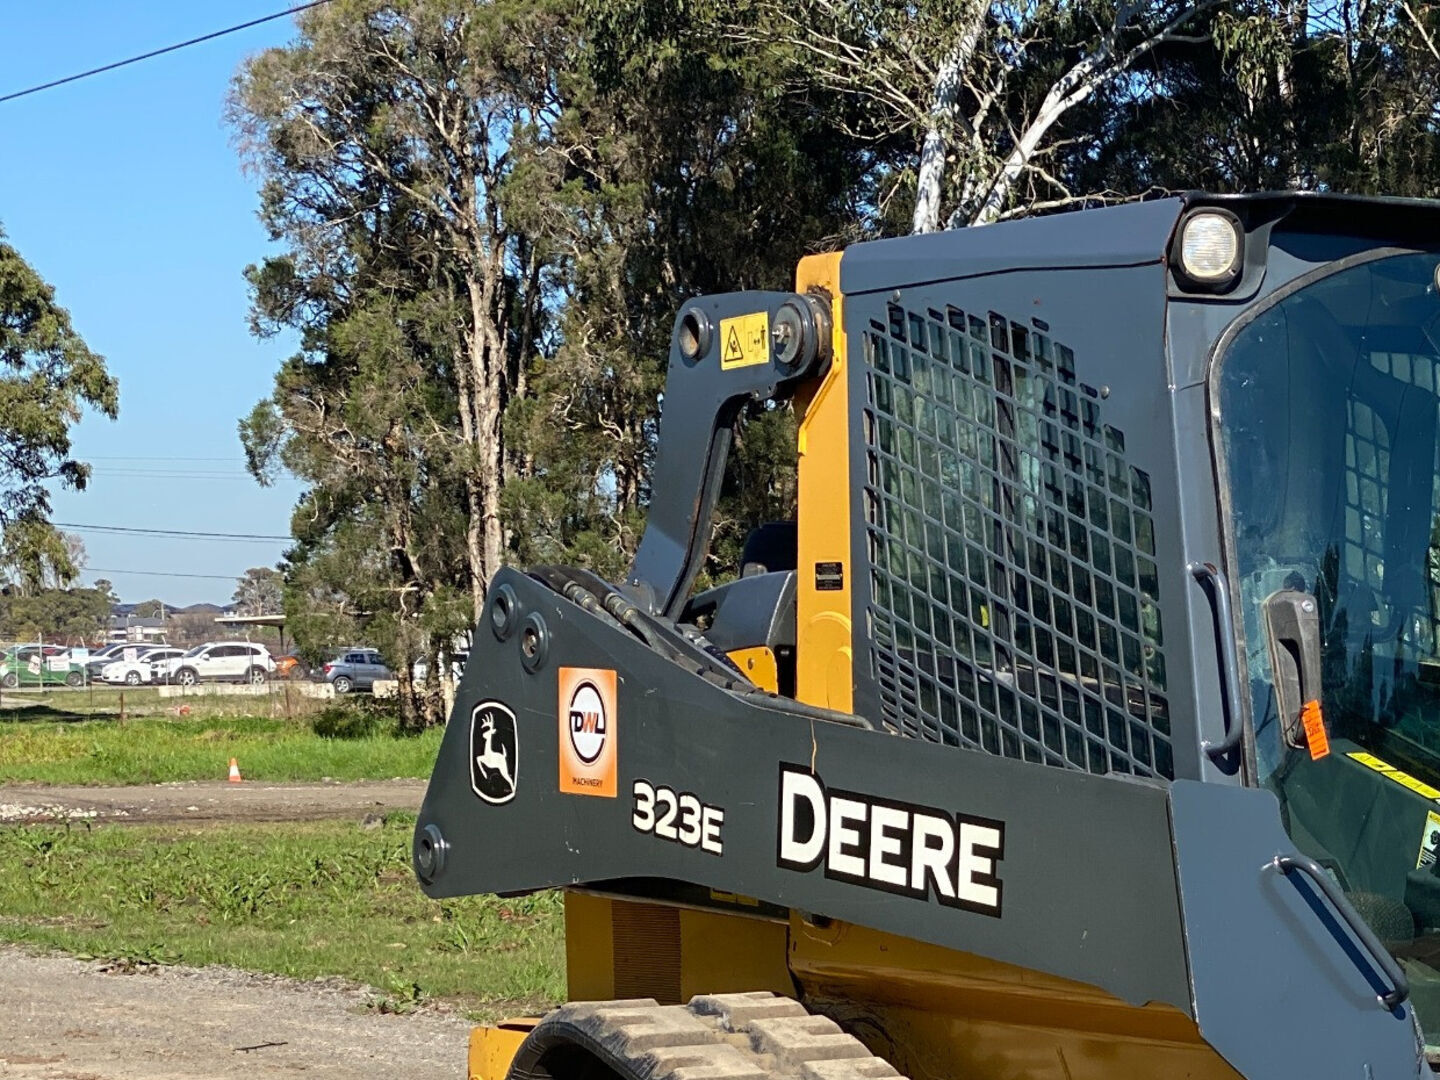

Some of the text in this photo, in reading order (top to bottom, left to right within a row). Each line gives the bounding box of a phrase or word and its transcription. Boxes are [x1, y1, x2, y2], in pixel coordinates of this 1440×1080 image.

[572, 777, 603, 788] MACHINERY
[634, 783, 723, 853] 323E
[781, 771, 999, 906] DEERE
